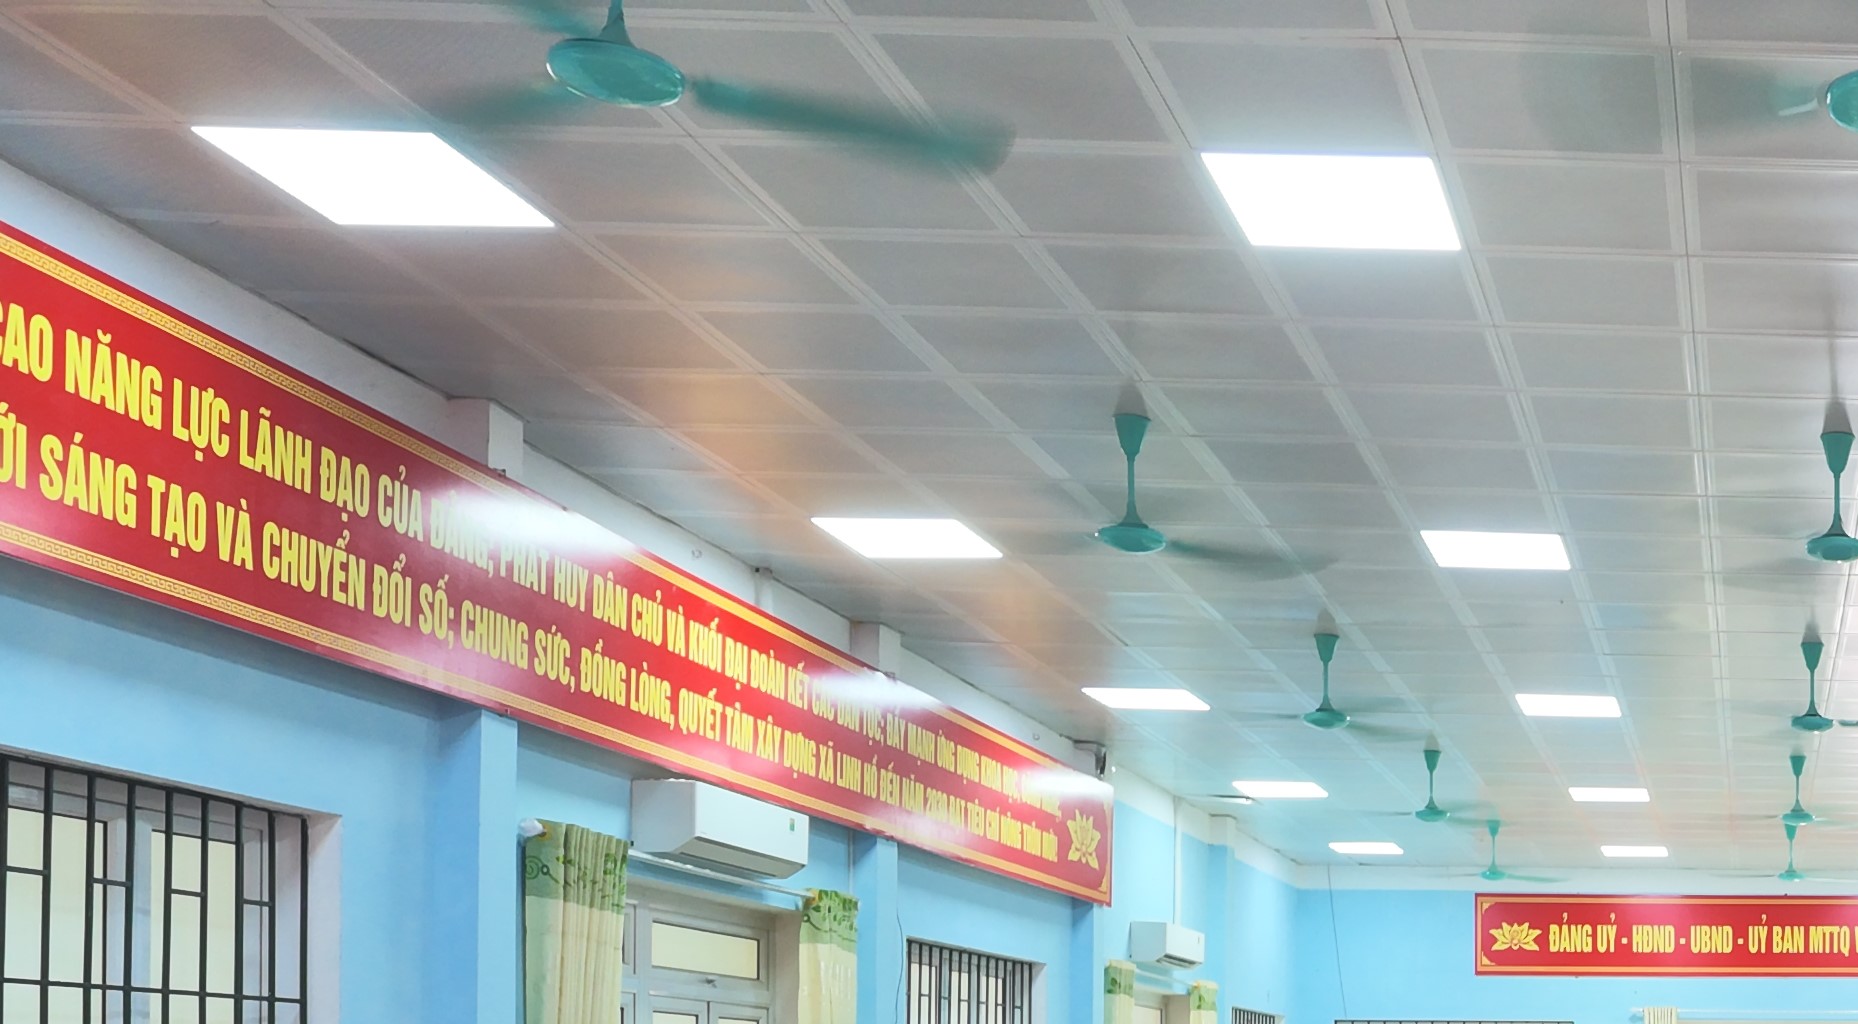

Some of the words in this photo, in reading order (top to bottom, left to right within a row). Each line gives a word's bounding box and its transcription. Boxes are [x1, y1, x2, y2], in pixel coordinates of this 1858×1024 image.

[0, 300, 53, 382] AO
[65, 328, 163, 431] NĂNG
[172, 377, 230, 462] LỰC
[239, 406, 312, 494] LÃNH
[319, 446, 370, 522] ĐẠO
[377, 465, 424, 542] CỦA
[553, 555, 589, 612] HUY
[592, 571, 627, 631] DÂN
[631, 589, 663, 646] CHỦ
[666, 605, 686, 657] VÀ
[688, 617, 722, 673] KHỐI
[725, 636, 748, 690] ĐẠI
[750, 649, 785, 700] ĐOÀN
[787, 661, 809, 710] KẾT
[39, 431, 137, 529] SÁNG
[147, 474, 207, 558] TẠO
[216, 498, 253, 571] VÀ
[262, 529, 365, 611] CHUYỂN
[372, 553, 412, 627] ĐỔI
[418, 574, 454, 649] SỐ;
[461, 600, 528, 670] CHUNG
[534, 625, 575, 693] SỨC,
[580, 638, 626, 707] ĐỒNG
[629, 661, 675, 731] LÒNG,
[678, 688, 723, 742] QUYẾT
[725, 702, 754, 754] TÂM
[756, 715, 782, 763] XÂY
[783, 730, 816, 779] DỰNG
[818, 741, 834, 784] XÃ
[837, 751, 861, 793] LINH
[864, 754, 878, 799] HỒ
[880, 762, 900, 806] ĐẾN
[902, 774, 924, 815] NĂM
[1549, 912, 1593, 953] ĐẢNG
[1596, 912, 1618, 953] UỶ
[1632, 924, 1675, 954] HĐND
[1690, 925, 1733, 954] UBND
[1748, 914, 1768, 954] UỶ
[1772, 925, 1804, 954] BAN
[1809, 925, 1850, 957] MTTQ
